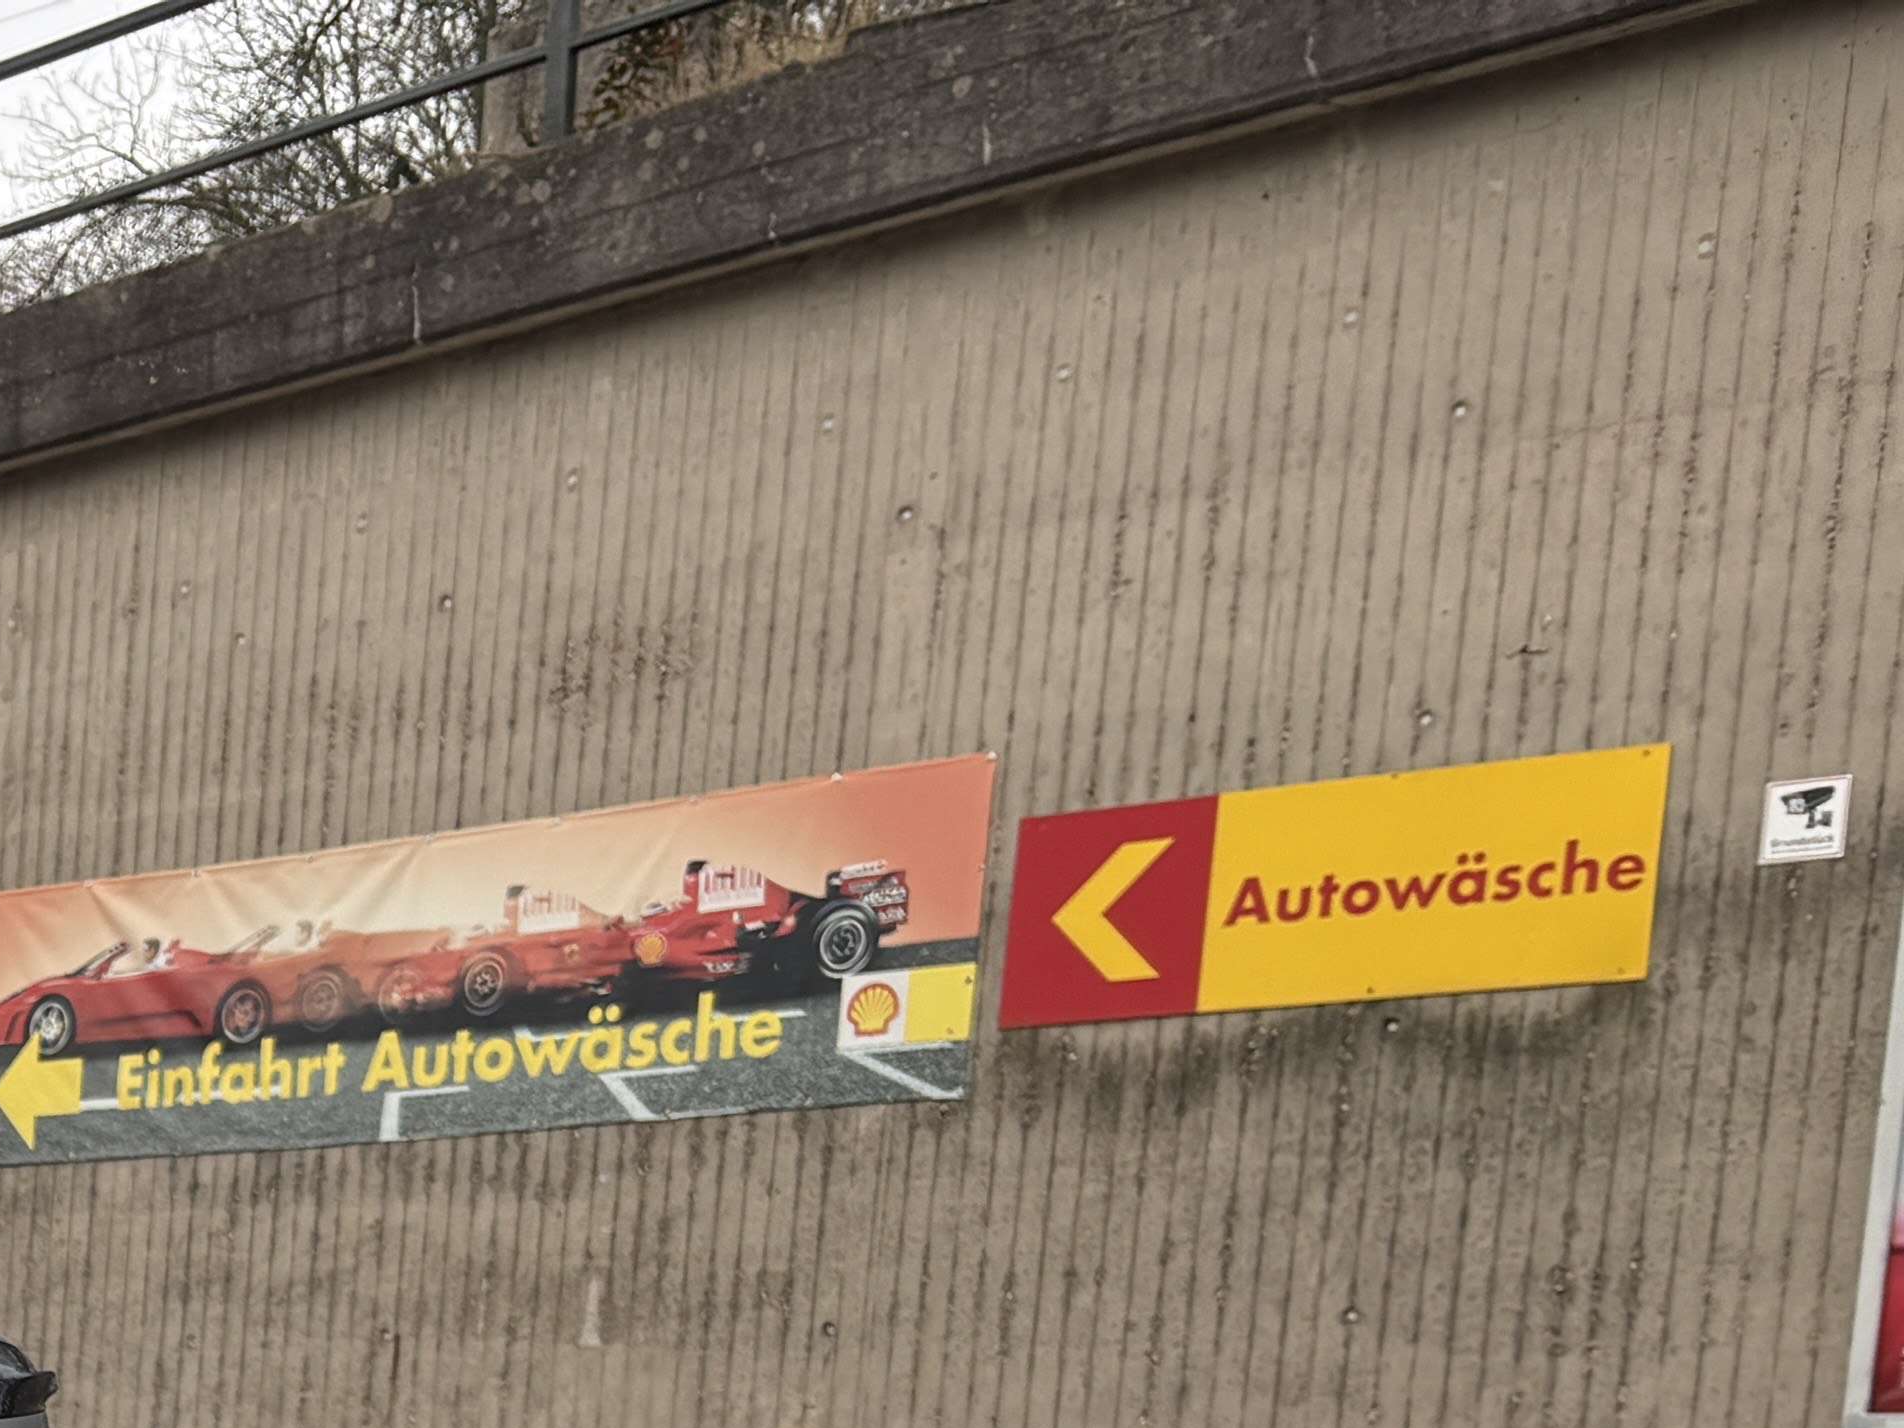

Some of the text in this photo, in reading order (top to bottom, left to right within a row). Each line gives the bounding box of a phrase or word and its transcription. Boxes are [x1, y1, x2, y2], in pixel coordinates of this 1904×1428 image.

[1222, 838, 1646, 928] Autowäsche
[116, 990, 784, 1111] Einfahrt Autowäsche
